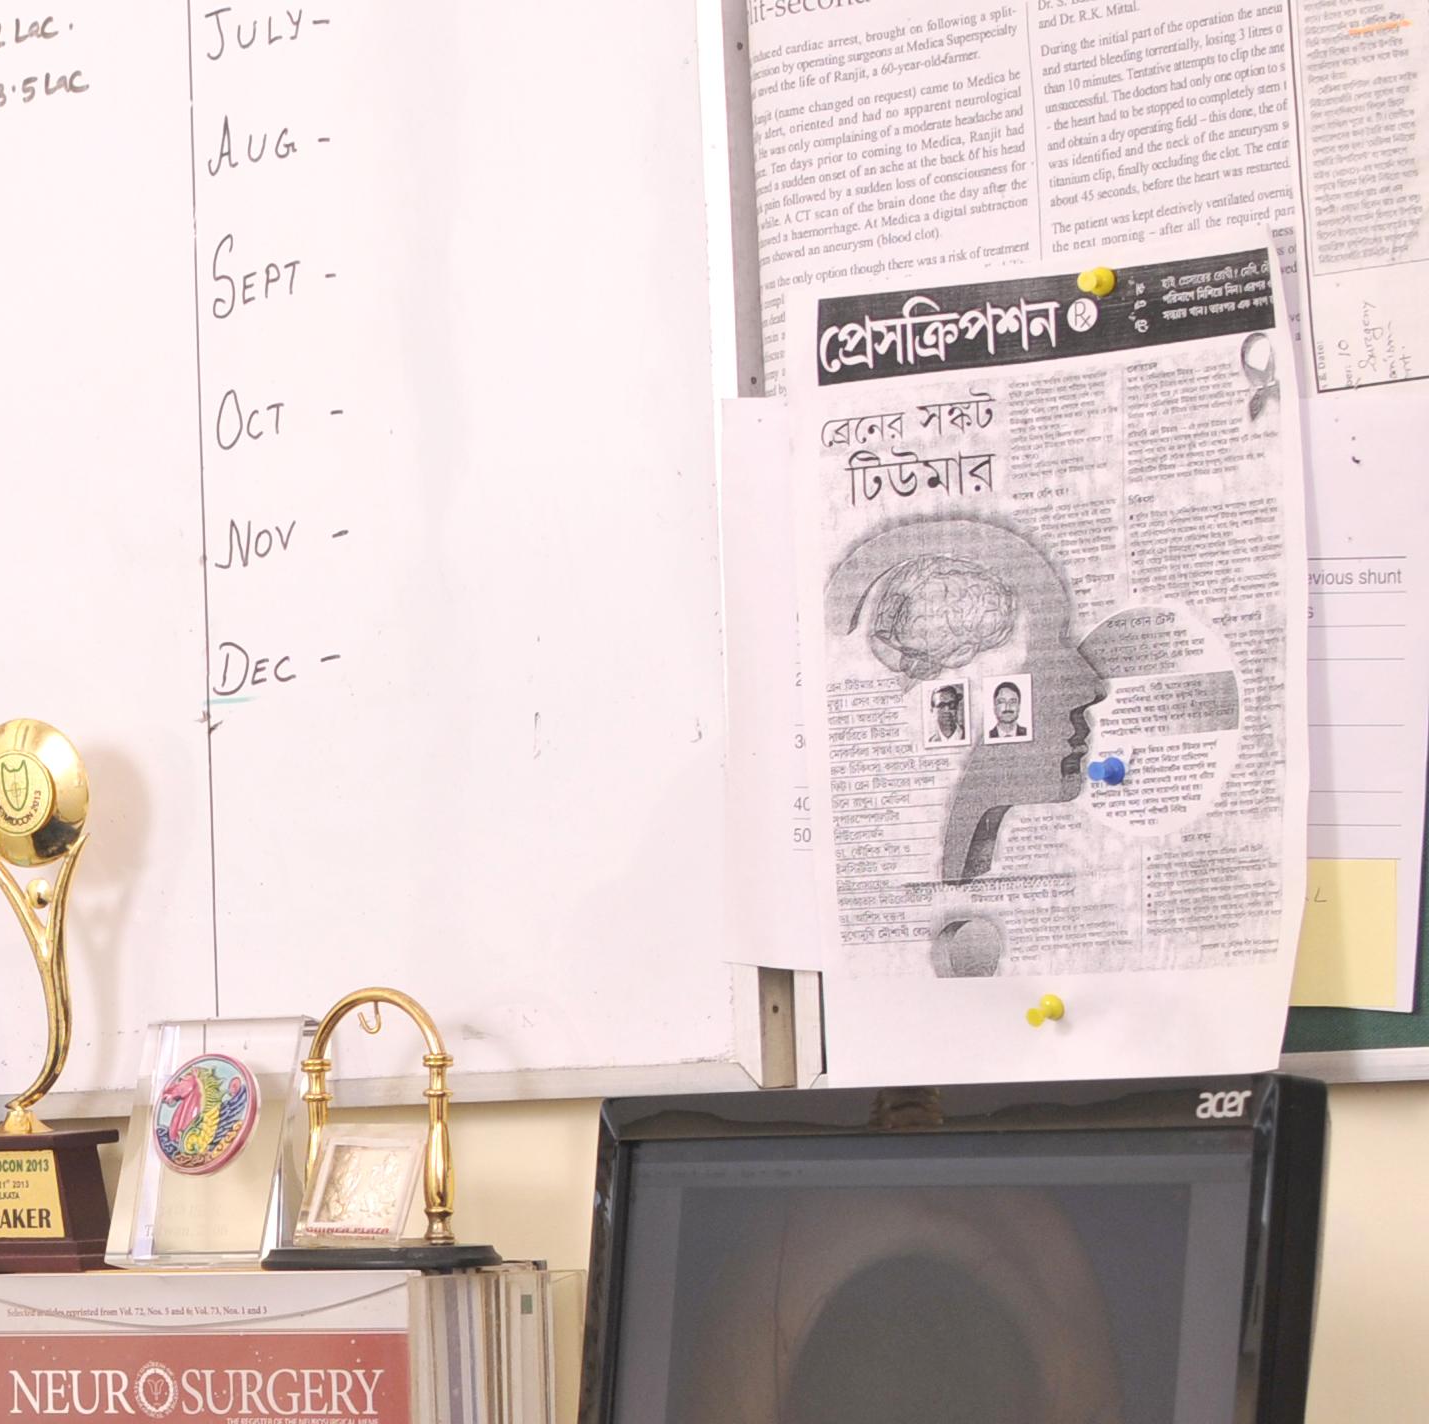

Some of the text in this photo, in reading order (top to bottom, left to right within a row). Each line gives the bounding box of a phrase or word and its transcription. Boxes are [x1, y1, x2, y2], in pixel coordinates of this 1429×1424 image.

[785, 15, 978, 55] cardiac brought following
[797, 24, 1018, 72] operating surgeons Medica Superspecialty
[1041, 15, 1234, 57] During operation
[1099, 49, 1143, 66] bleeding
[789, 86, 1023, 134] oriented apparent neurological
[808, 73, 1005, 114] changed request) Medica
[1199, 87, 1254, 108] completely
[813, 110, 1003, 151] complaining moderate headache
[861, 130, 1002, 162] coming Ranjit
[1072, 124, 1280, 166] identified aneurysm
[933, 165, 1008, 184] consciousness
[970, 196, 1029, 215] subtraction
[1206, 192, 1255, 209] ventilated
[823, 238, 874, 255] aneurysm
[820, 296, 1060, 373] প্রেসক্রিপশন
[821, 412, 905, 447] ব্রেনের
[845, 446, 996, 506] টিউমার
[1358, 568, 1402, 585] shunt
[793, 828, 812, 843] 50
[1196, 1090, 1252, 1119] acer
[26, 1159, 50, 1173] 2013
[9, 1363, 384, 1416] NEUROSURGERY
